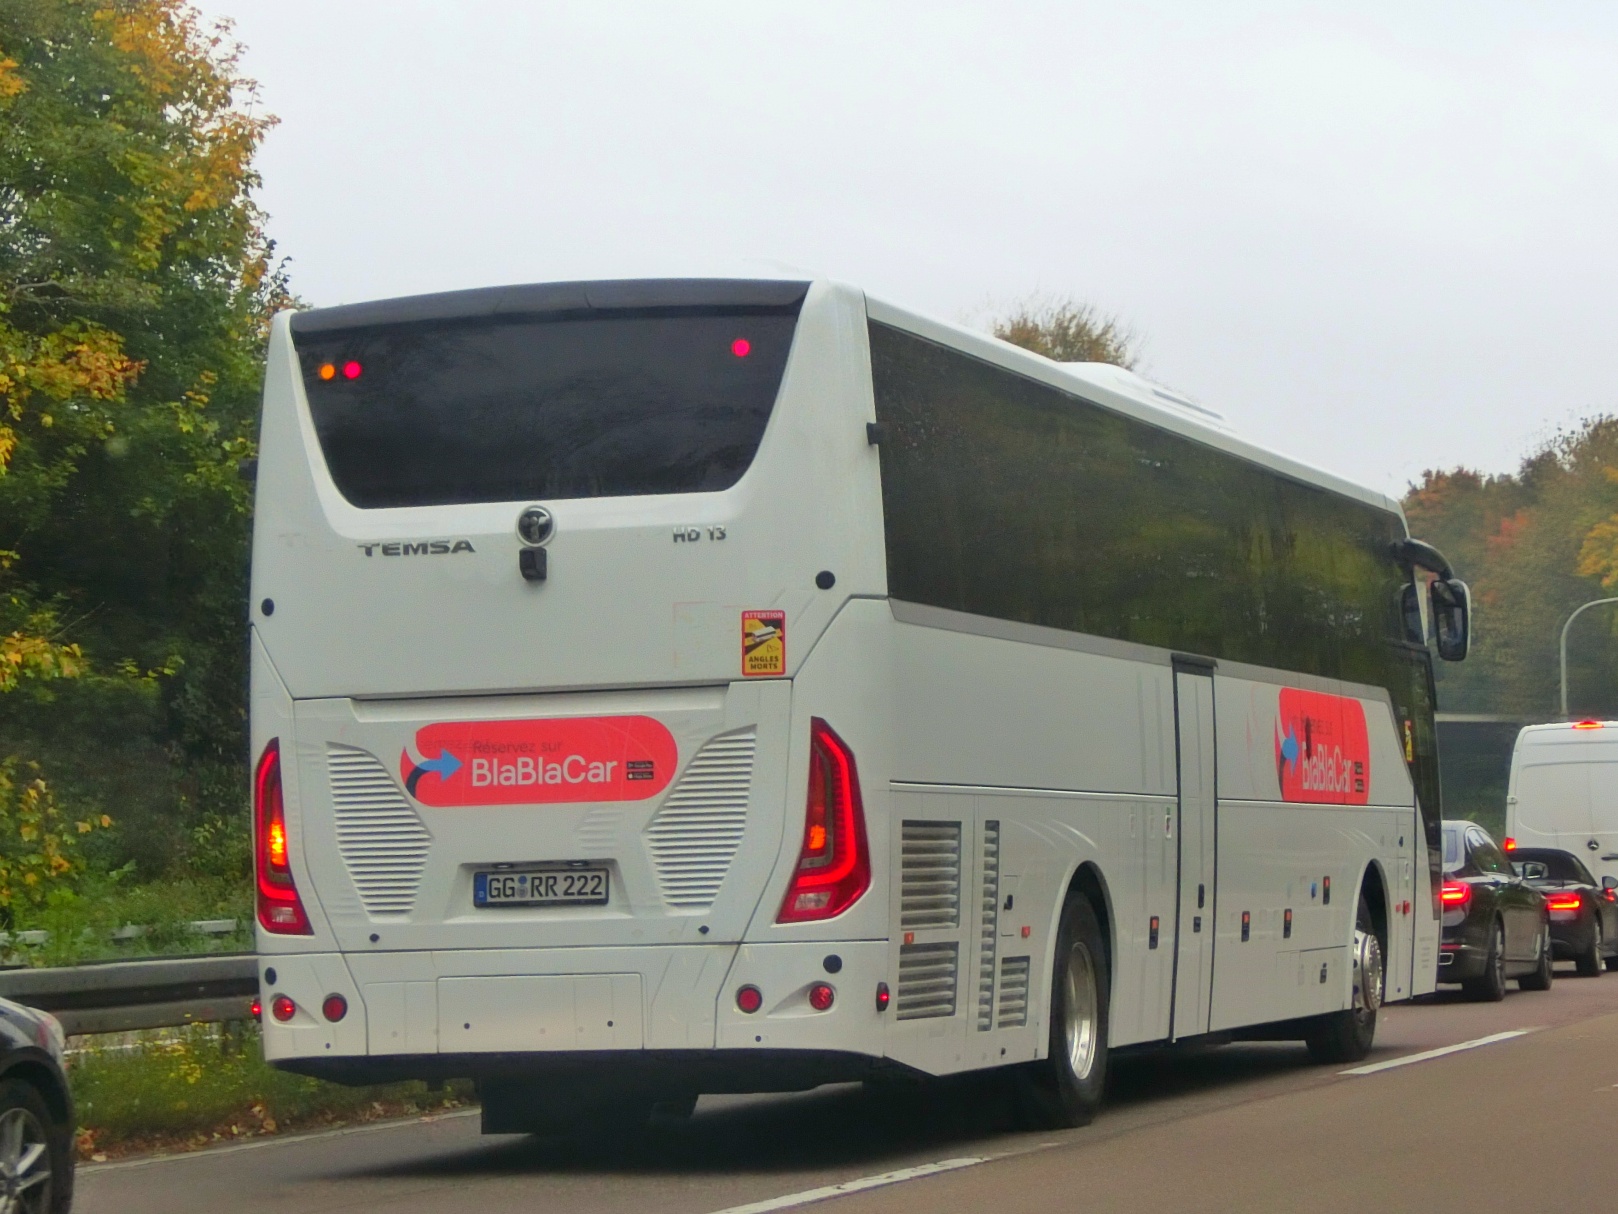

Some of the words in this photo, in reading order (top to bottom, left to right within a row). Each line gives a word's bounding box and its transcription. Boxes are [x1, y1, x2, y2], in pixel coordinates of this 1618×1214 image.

[673, 526, 701, 543] HD
[707, 525, 727, 541] 13
[357, 539, 476, 557] TEMSA
[744, 611, 783, 619] ATTENTION
[748, 655, 779, 663] ANGLES
[541, 740, 562, 752] sur
[472, 754, 618, 787] BlaBlaCar
[489, 878, 515, 898] GG
[531, 876, 558, 897] RR
[563, 875, 603, 896] 222
